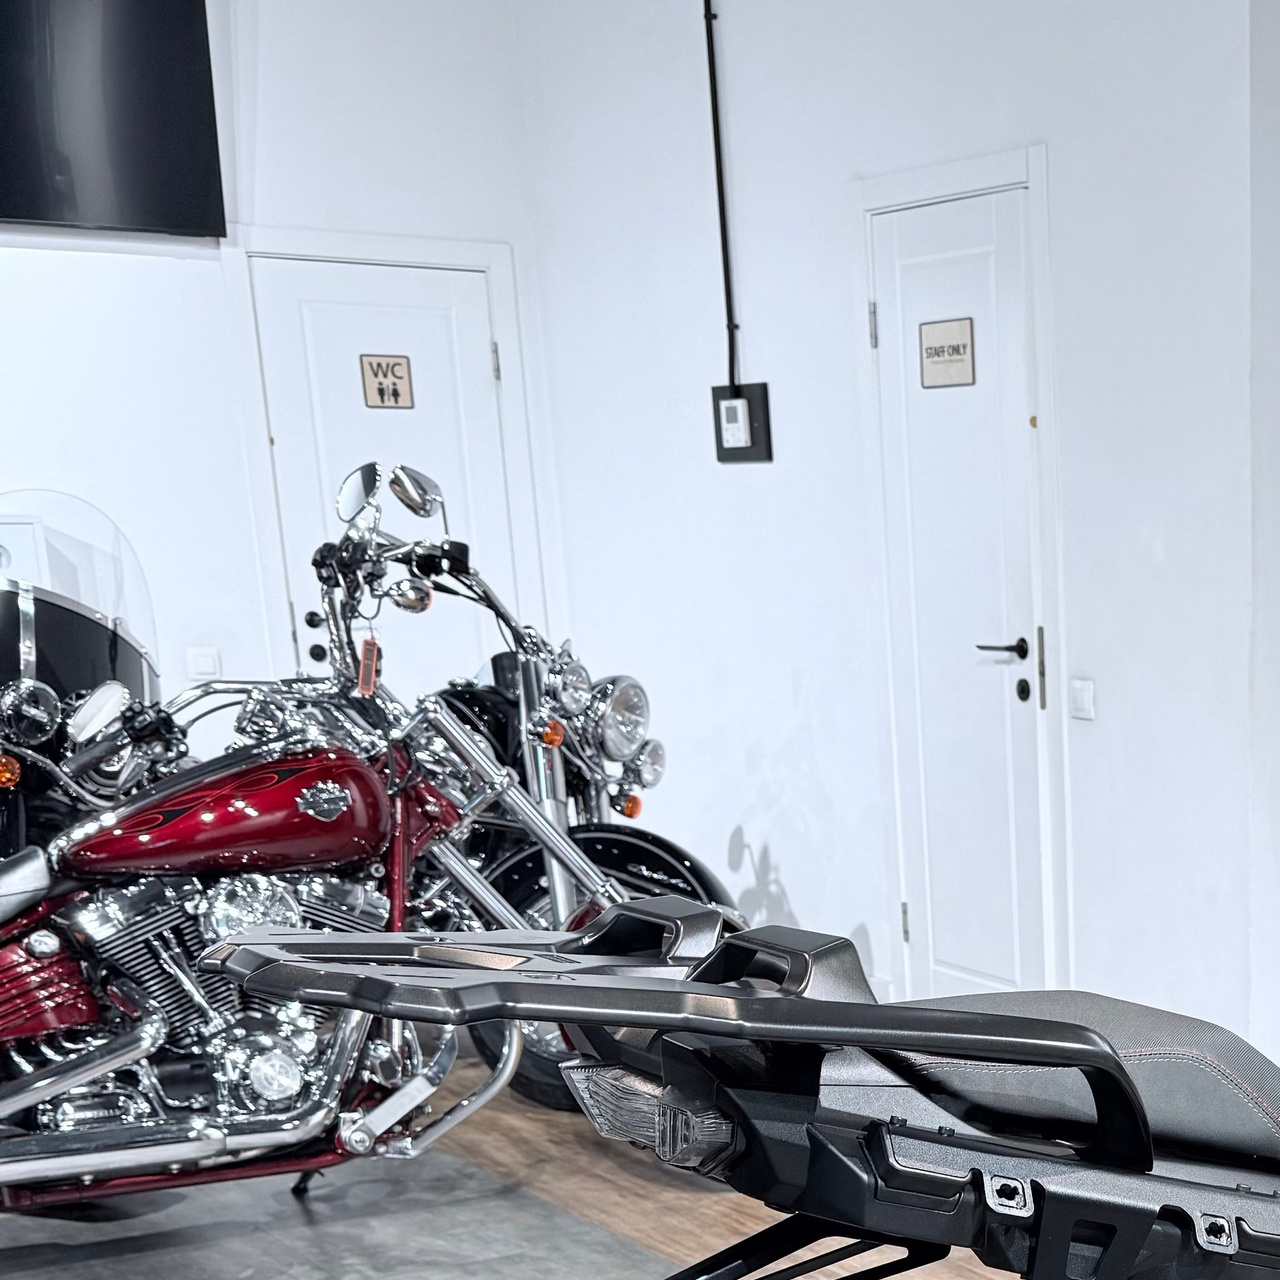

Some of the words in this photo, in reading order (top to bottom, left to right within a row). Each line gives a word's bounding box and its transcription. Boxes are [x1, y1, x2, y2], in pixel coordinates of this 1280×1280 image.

[925, 346, 946, 359] STAFF
[947, 343, 968, 357] ONLY
[369, 361, 404, 380] WC
